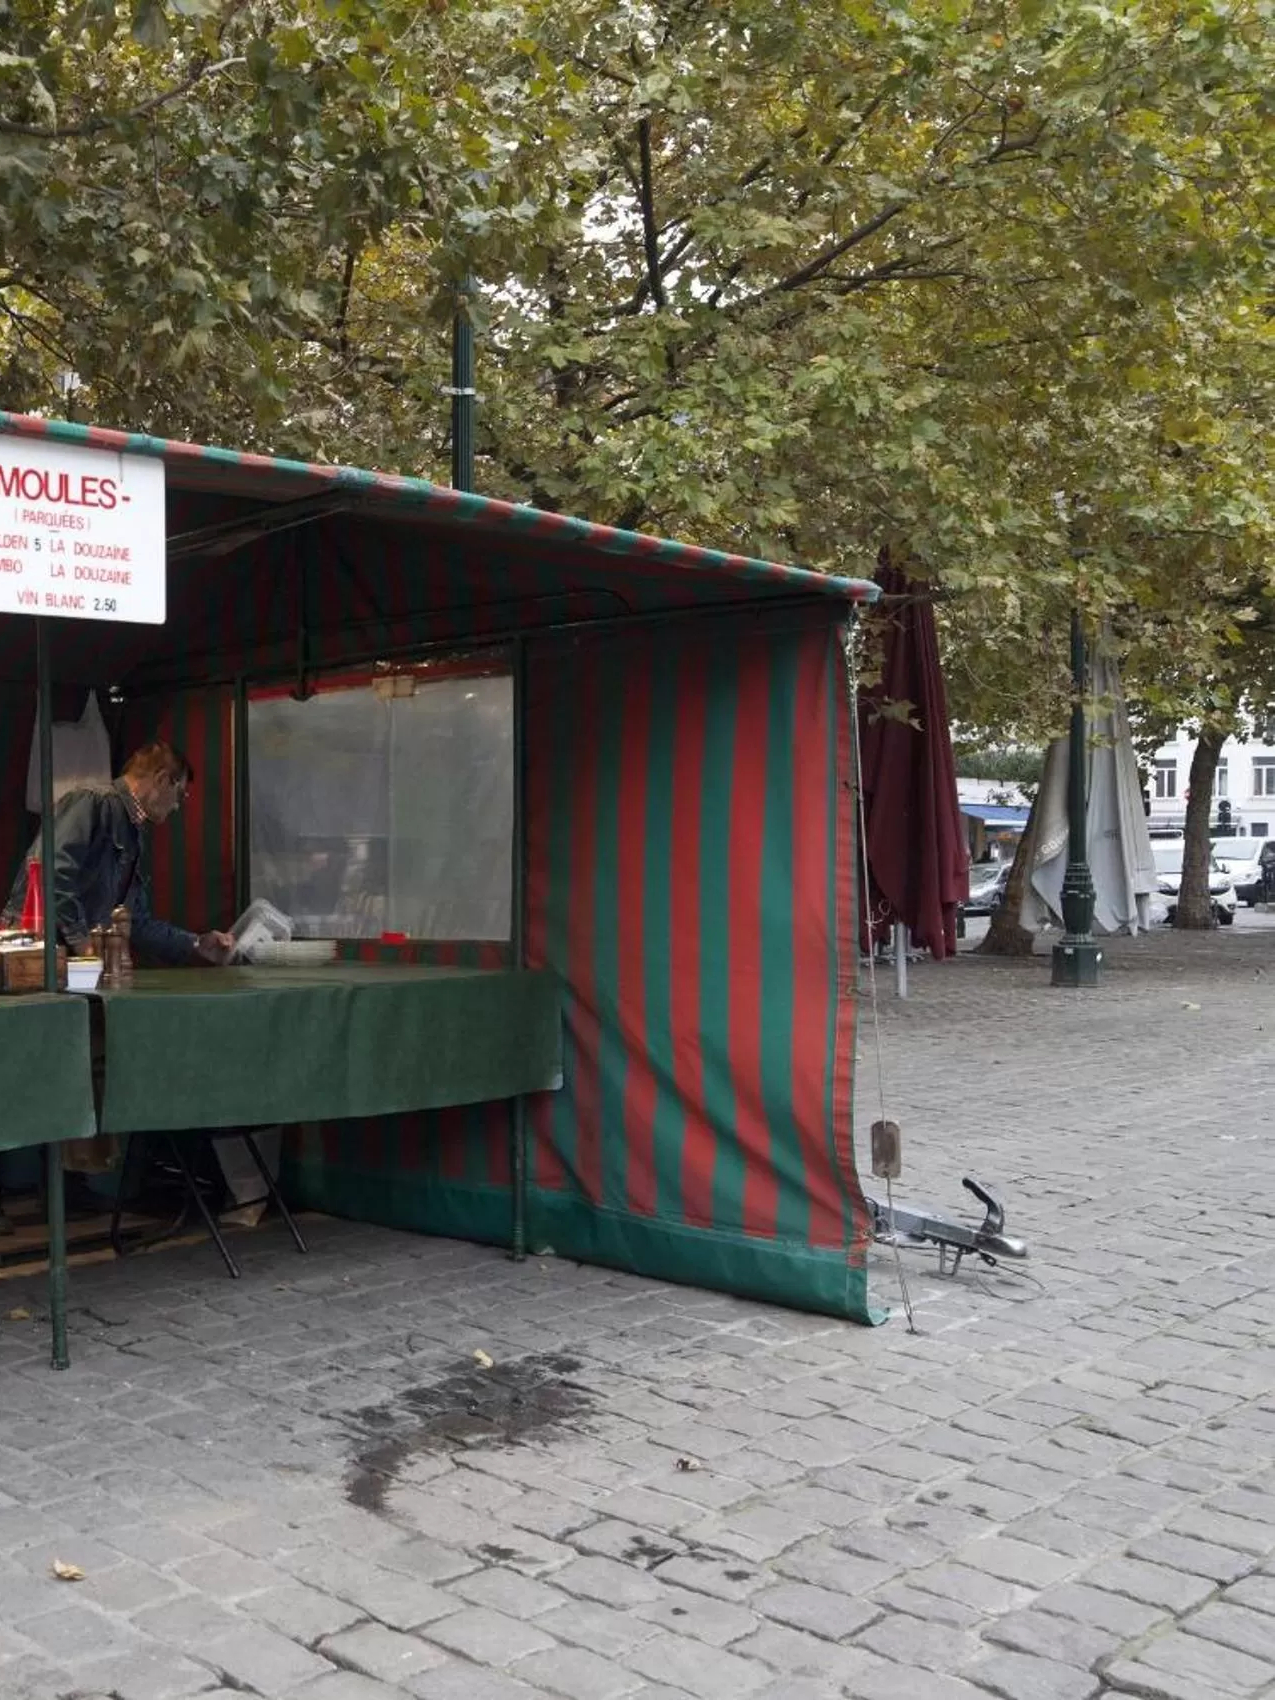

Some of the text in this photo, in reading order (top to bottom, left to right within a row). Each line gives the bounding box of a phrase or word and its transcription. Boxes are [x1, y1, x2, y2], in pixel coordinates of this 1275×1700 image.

[50, 538, 65, 553] LA
[50, 563, 65, 578] LA
[45, 592, 85, 610] BLANC
